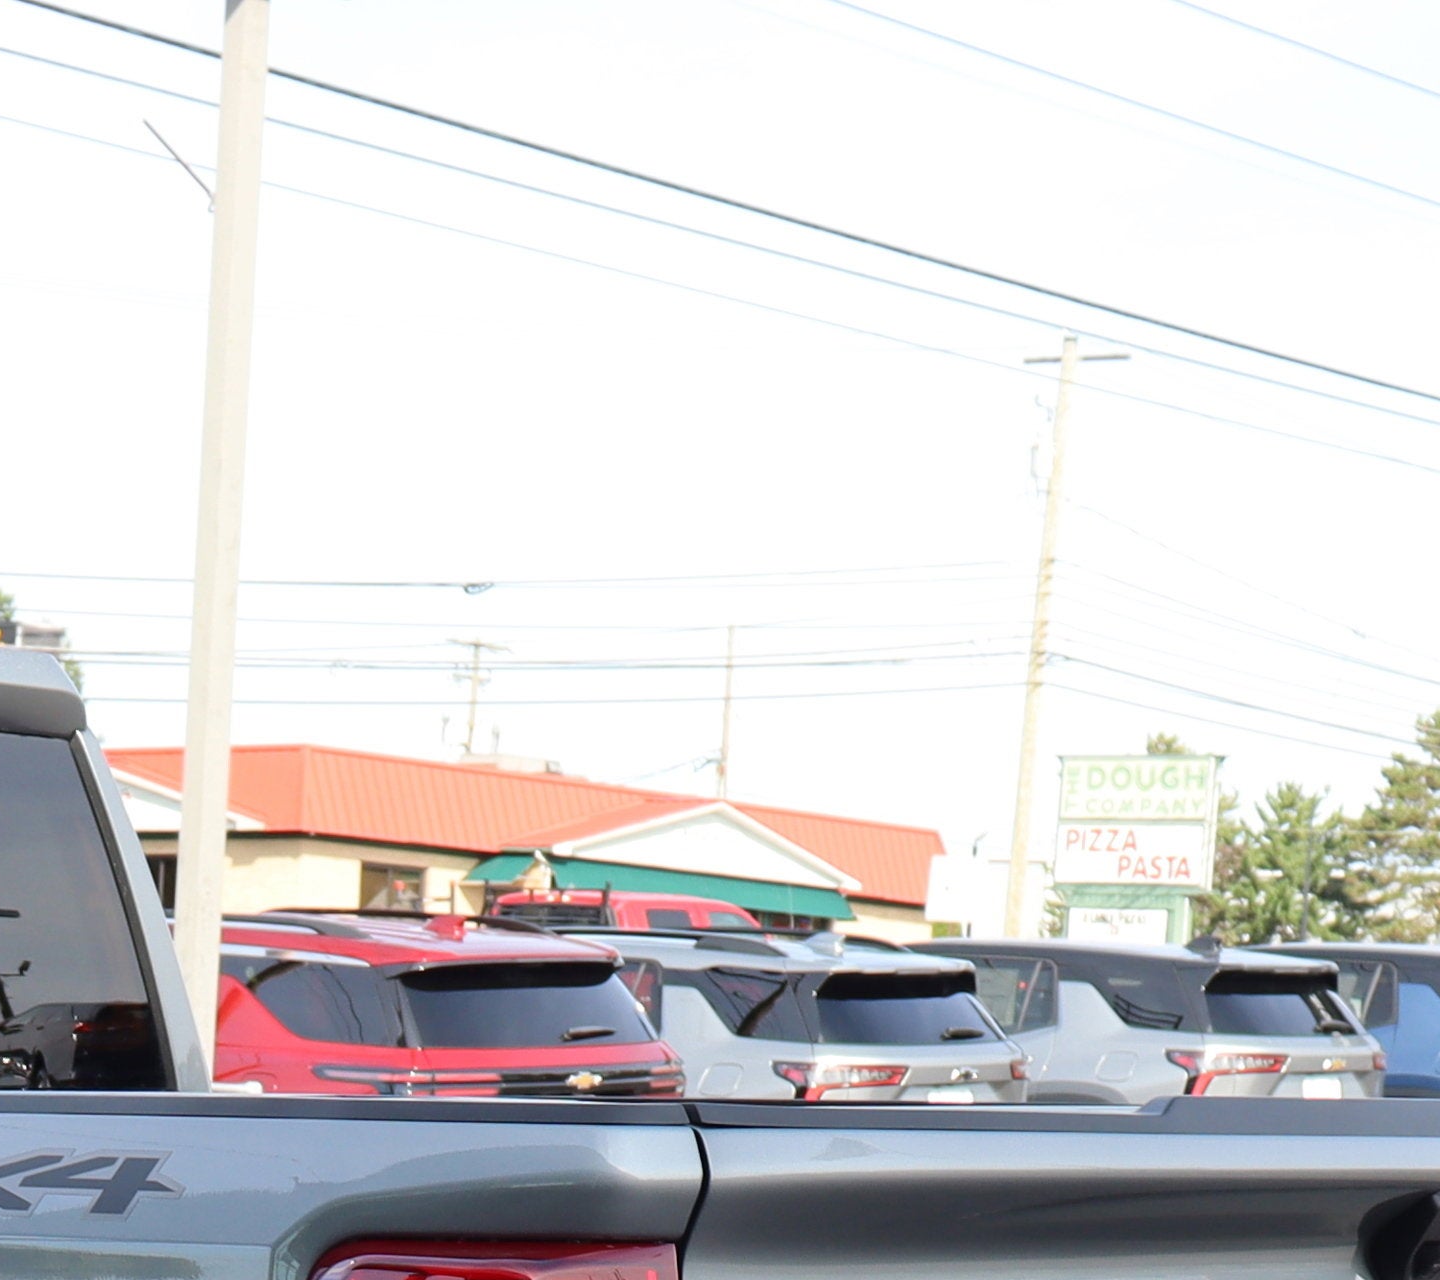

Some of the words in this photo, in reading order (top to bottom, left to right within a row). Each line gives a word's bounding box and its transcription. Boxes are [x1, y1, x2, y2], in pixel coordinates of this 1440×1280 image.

[1087, 765, 1206, 791] DOUGH
[1086, 798, 1203, 814] COMPANY
[1066, 828, 1138, 852] PIZZA
[1117, 855, 1191, 880] PASTA
